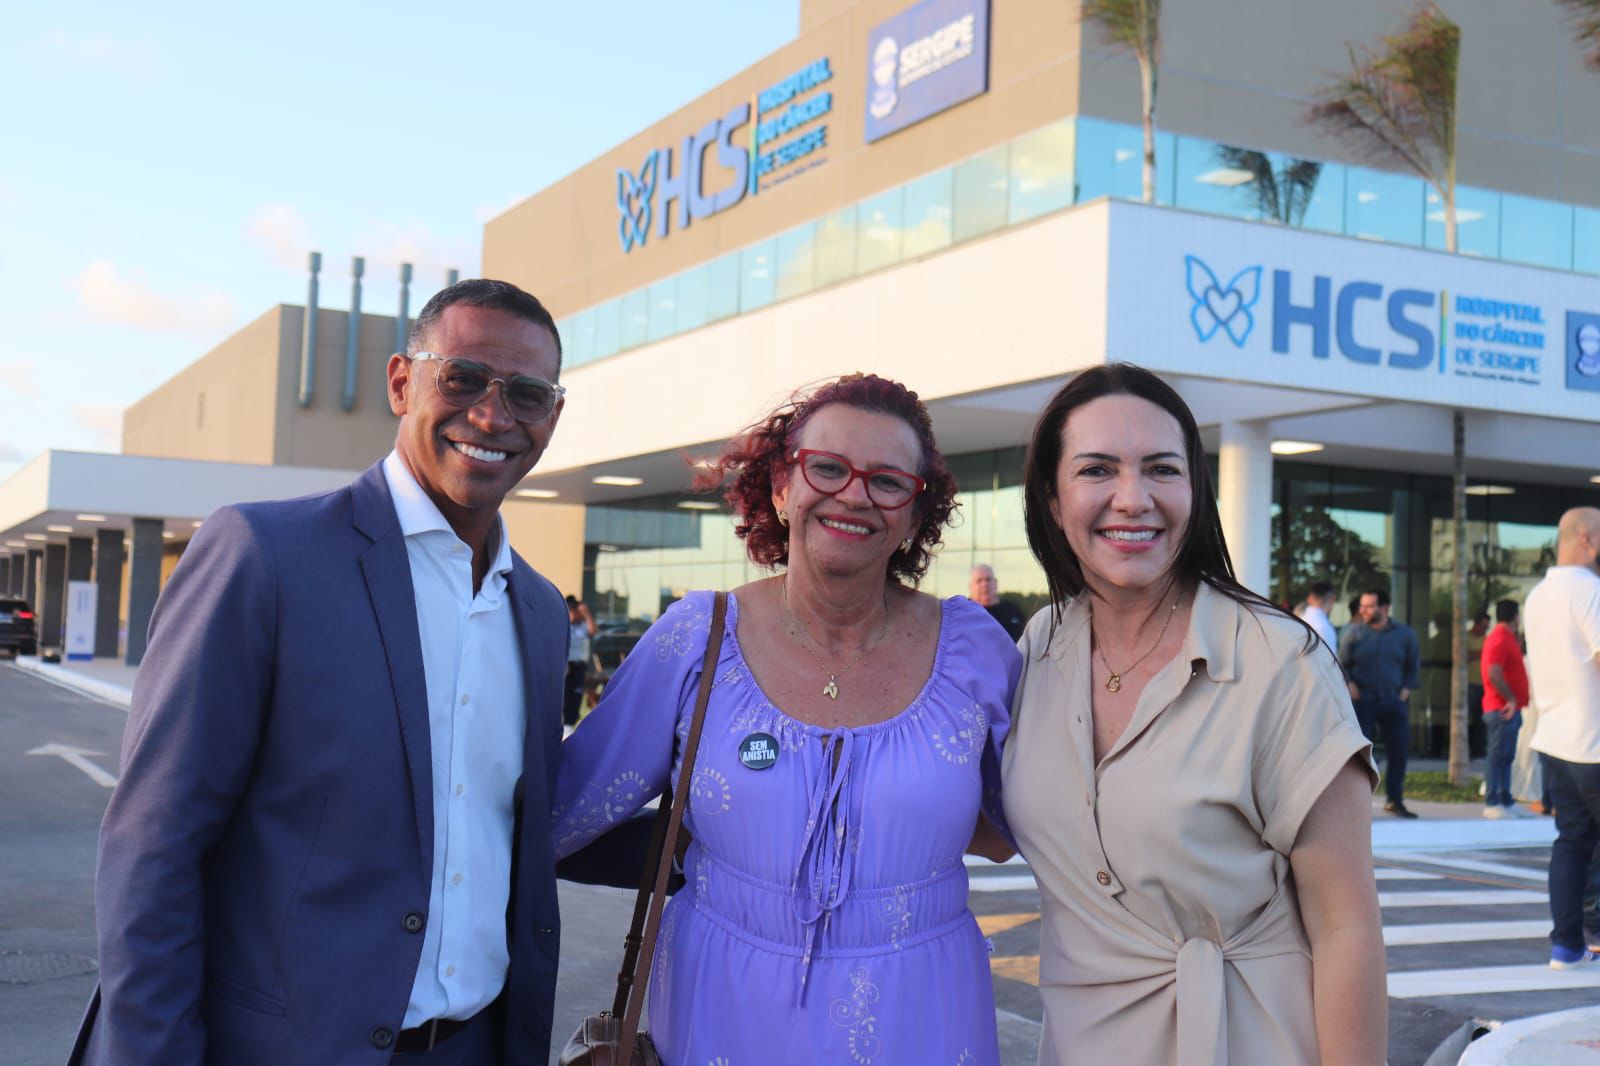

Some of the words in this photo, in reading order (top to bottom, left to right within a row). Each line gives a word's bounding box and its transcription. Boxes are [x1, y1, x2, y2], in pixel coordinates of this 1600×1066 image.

[656, 102, 750, 237] HCS
[1271, 268, 1436, 371] HCS
[1455, 295, 1545, 325] HOSPITAL
[1455, 347, 1474, 366] DE
[1479, 350, 1541, 375] SERGIPE
[742, 749, 776, 761] ANISTIA
[750, 740, 768, 750] SEM
